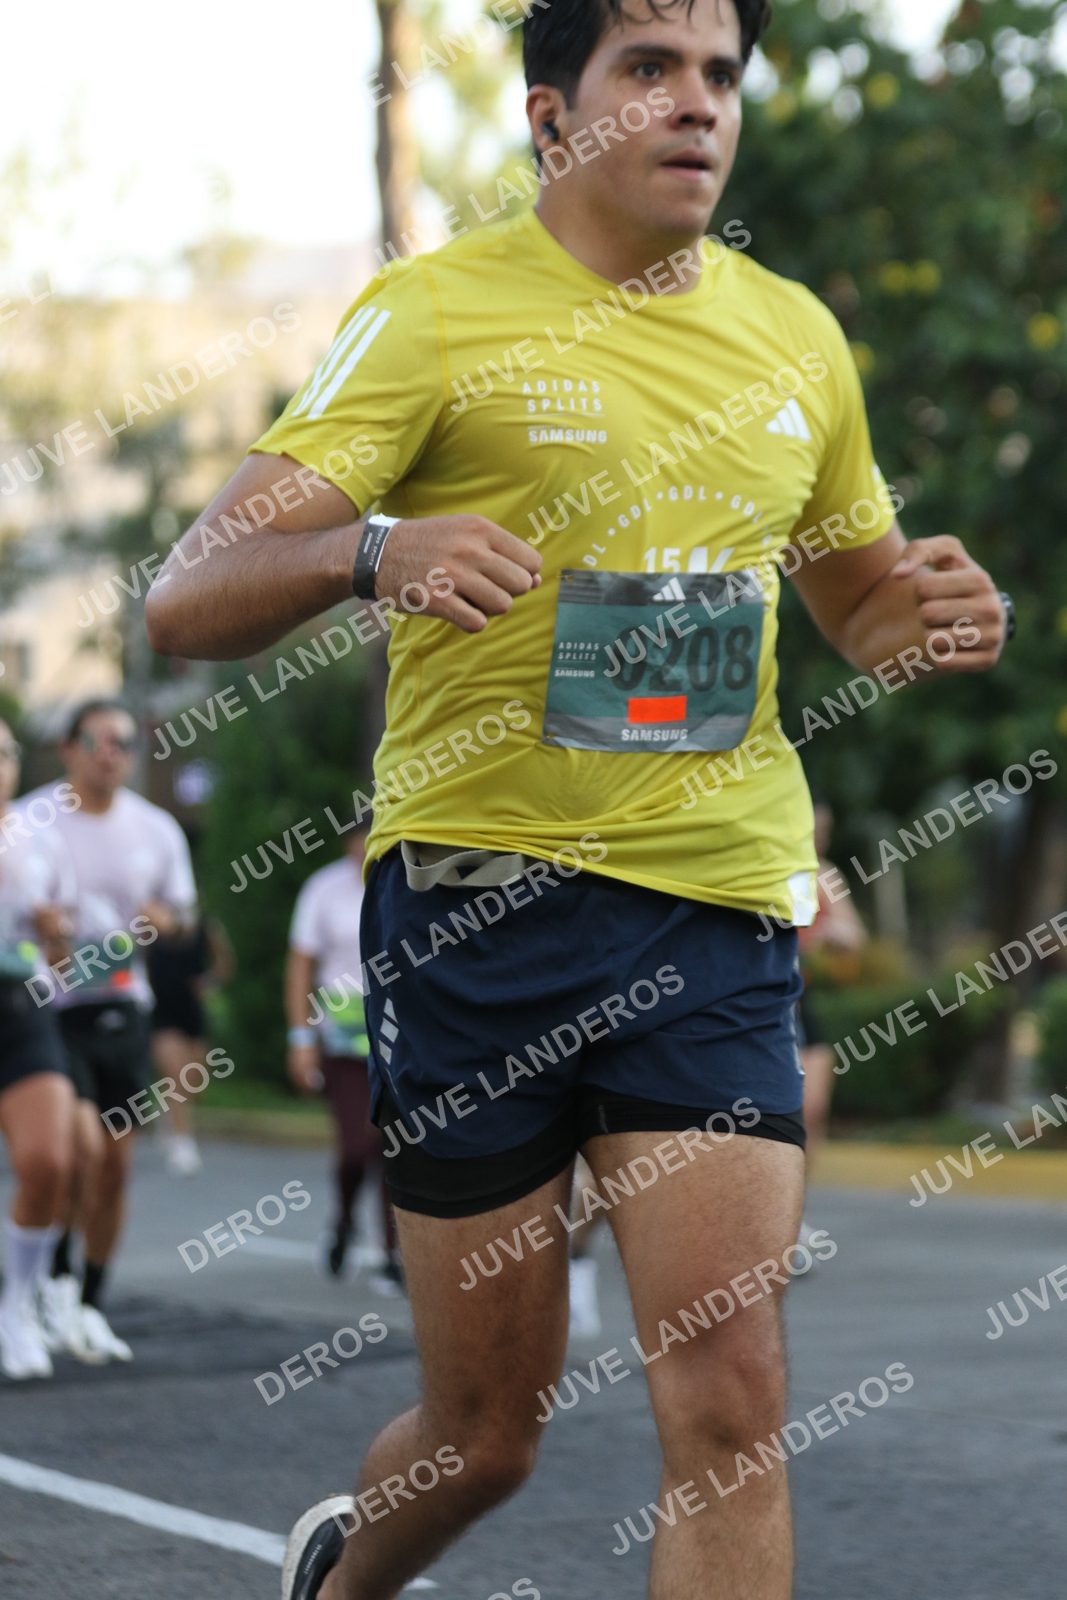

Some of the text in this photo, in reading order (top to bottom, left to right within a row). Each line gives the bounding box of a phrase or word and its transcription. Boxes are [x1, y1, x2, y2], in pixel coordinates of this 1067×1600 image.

[522, 379, 600, 393] ADIDAS
[527, 398, 602, 412] SPLITS
[528, 429, 607, 444] SAMSUNG
[617, 499, 652, 528] GDL
[668, 485, 706, 502] GDL
[558, 641, 600, 650] ADIDAS
[558, 652, 597, 660] SPLITS
[612, 624, 754, 692] 0208
[554, 669, 595, 678] SAMSUNG
[621, 728, 688, 741] SAMSUNG
